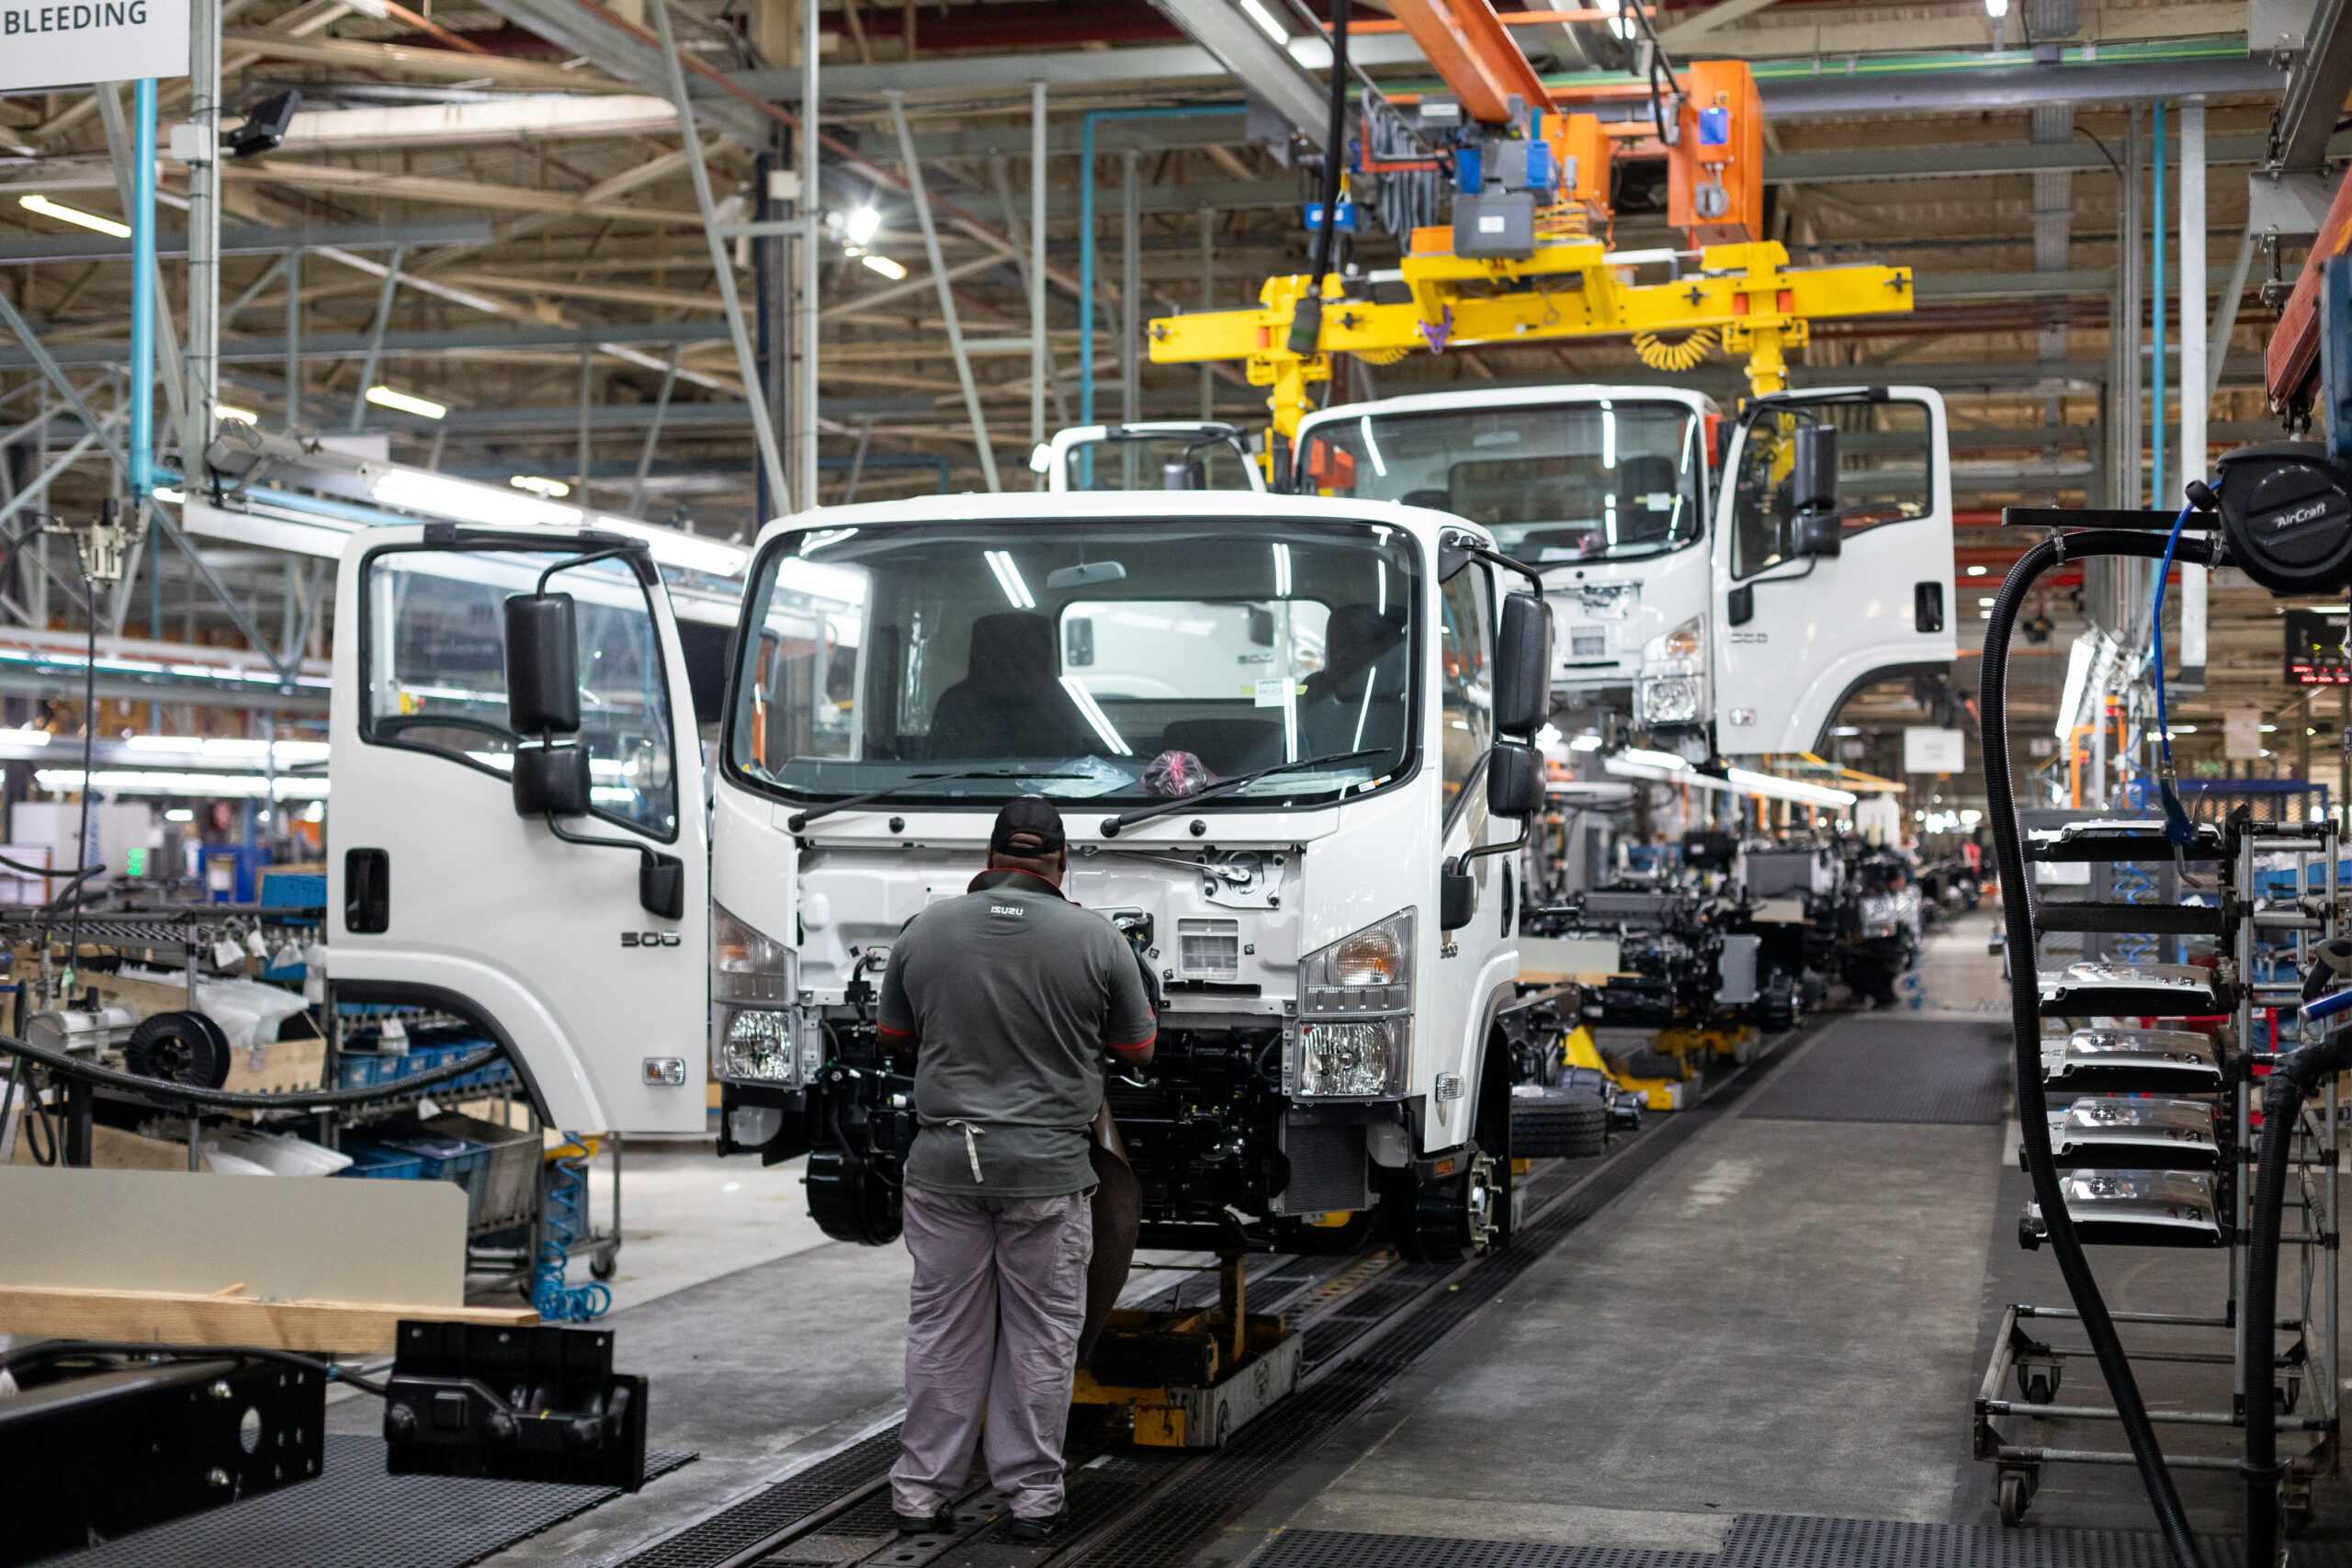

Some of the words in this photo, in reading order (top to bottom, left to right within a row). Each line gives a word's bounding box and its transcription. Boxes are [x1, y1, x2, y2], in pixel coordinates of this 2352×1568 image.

[5, 0, 147, 35] BLEEDING
[2276, 502, 2326, 528] AirCraft
[990, 906, 1023, 916] ISUZU
